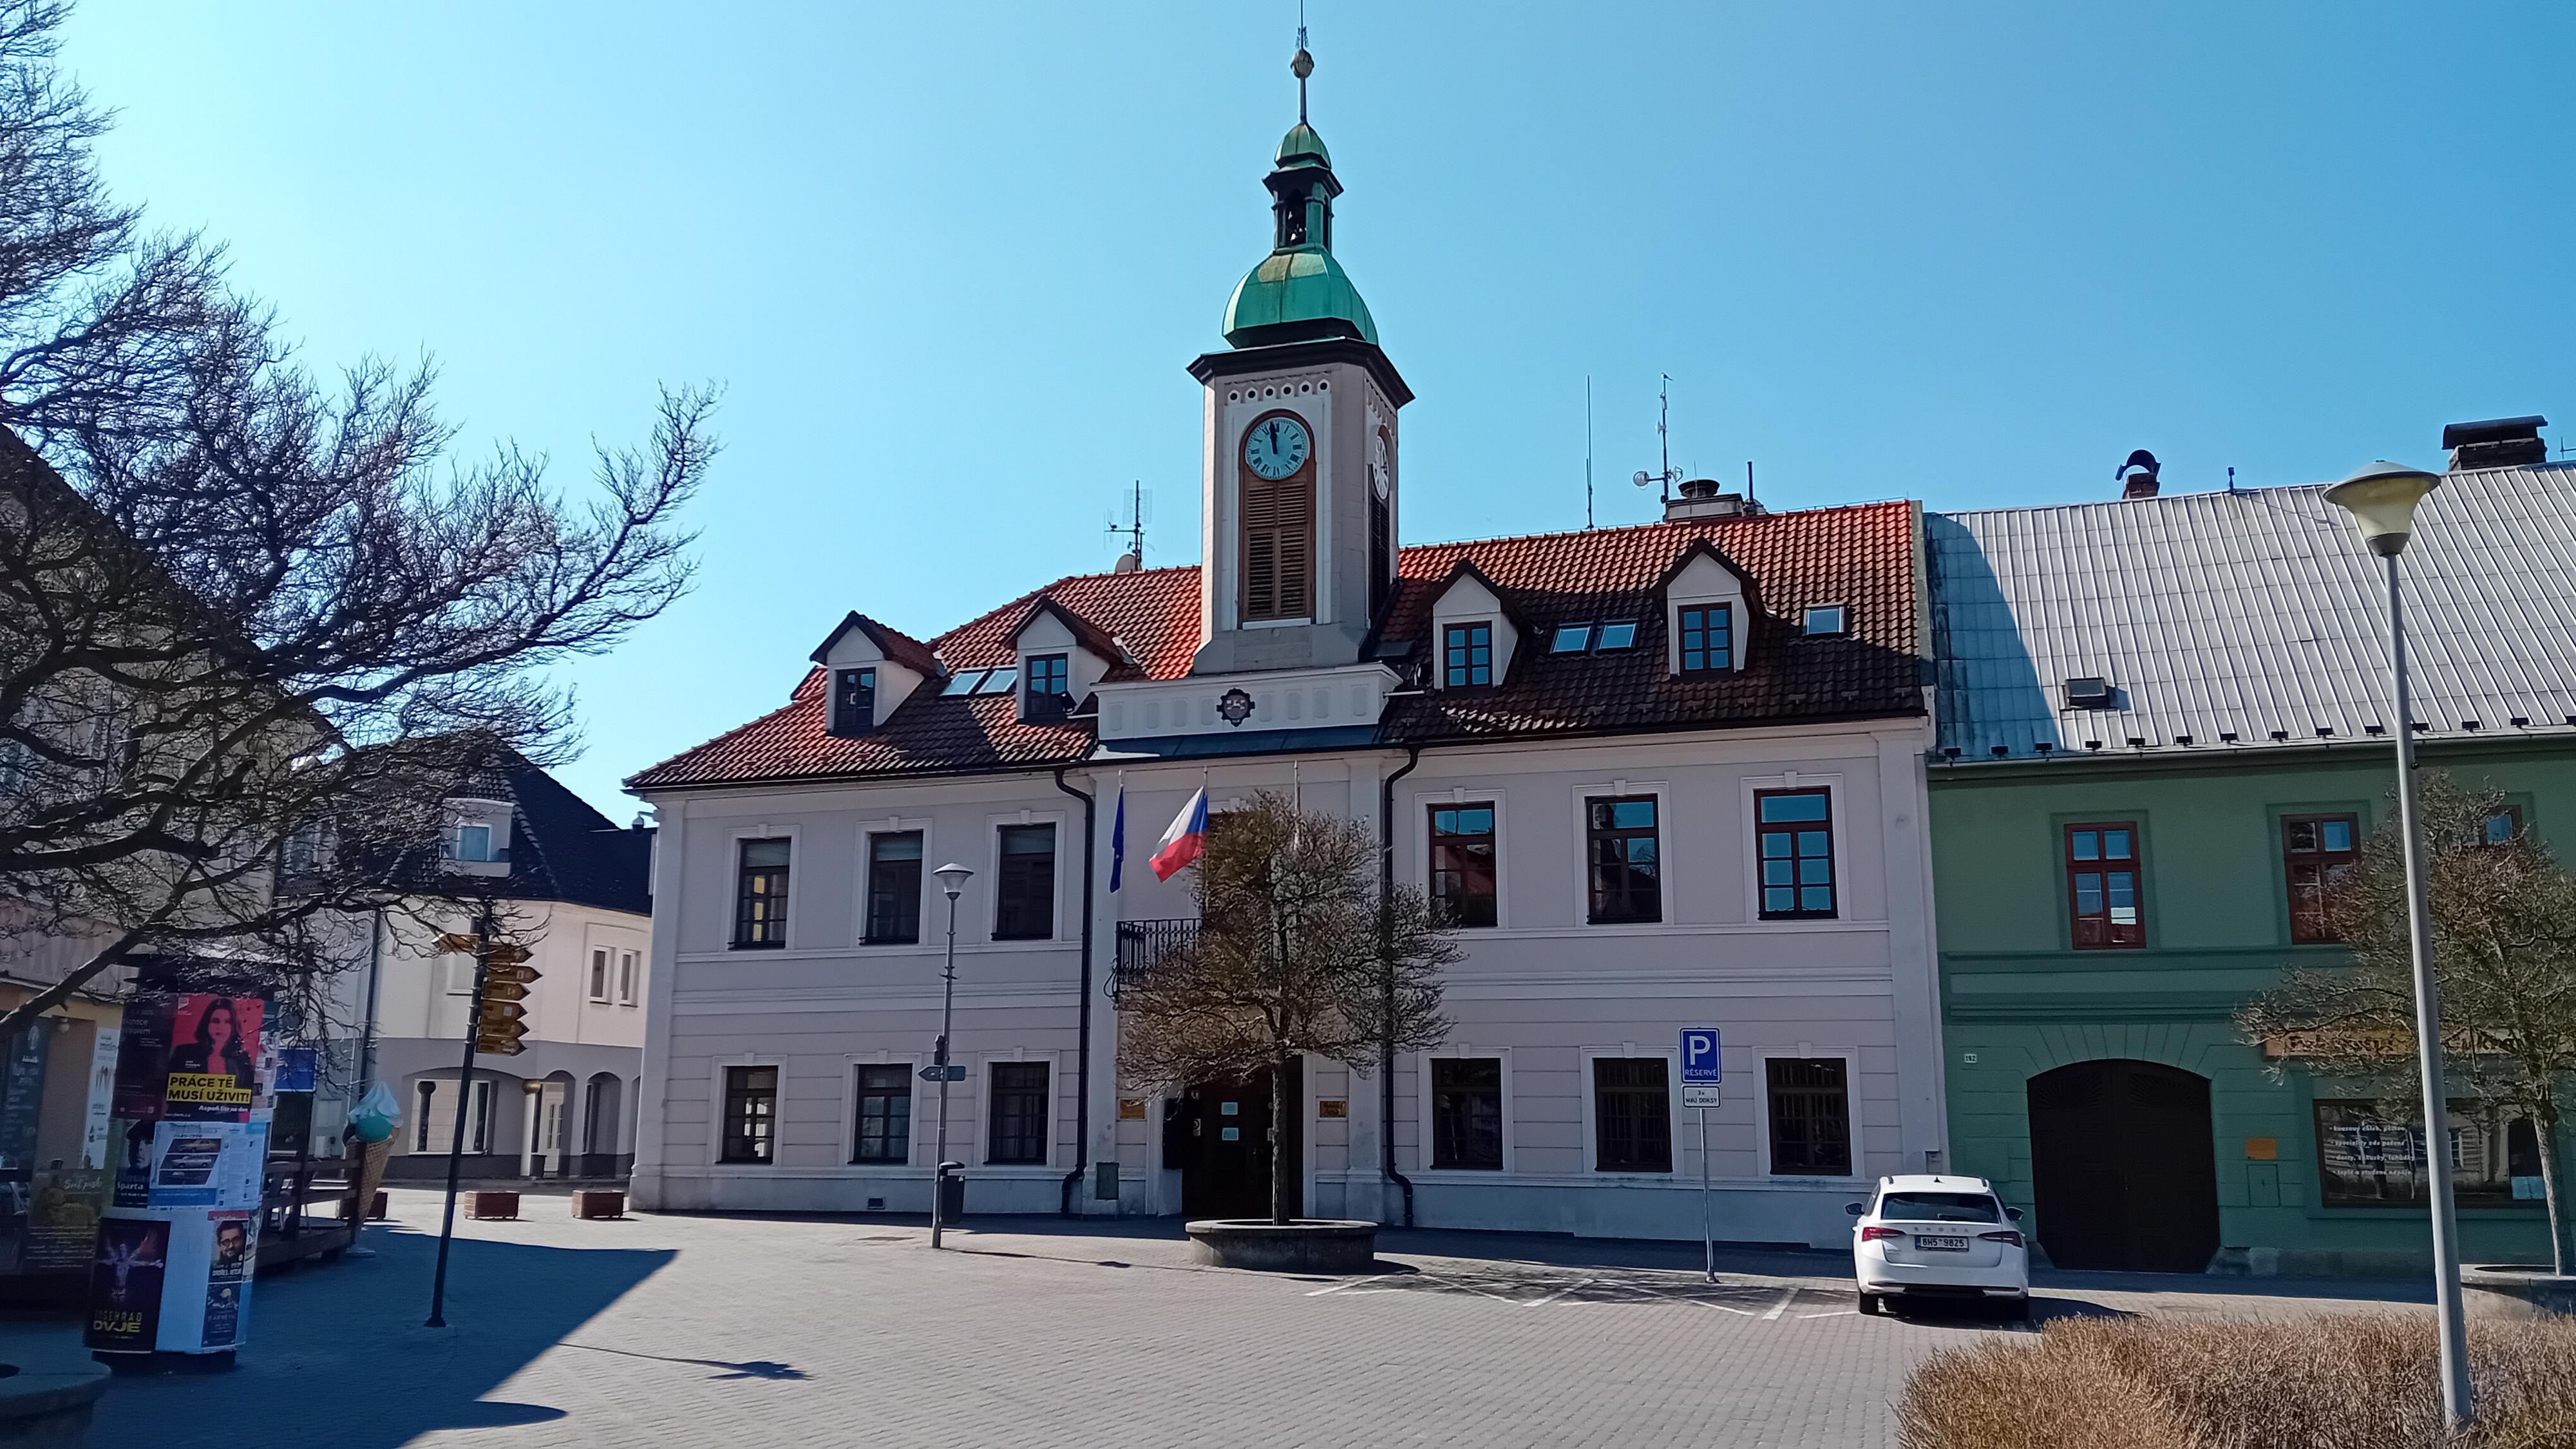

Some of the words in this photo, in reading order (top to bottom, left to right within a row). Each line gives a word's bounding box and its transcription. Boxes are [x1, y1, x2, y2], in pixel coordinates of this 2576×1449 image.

[1689, 1036, 1710, 1065] P
[1684, 1068, 1717, 1077] RÉSERVÉ
[169, 1075, 215, 1087] PRÁCE
[218, 1076, 233, 1088] TĚ
[168, 1088, 204, 1100] MUSÍ
[207, 1089, 249, 1102] UŽIVIT!
